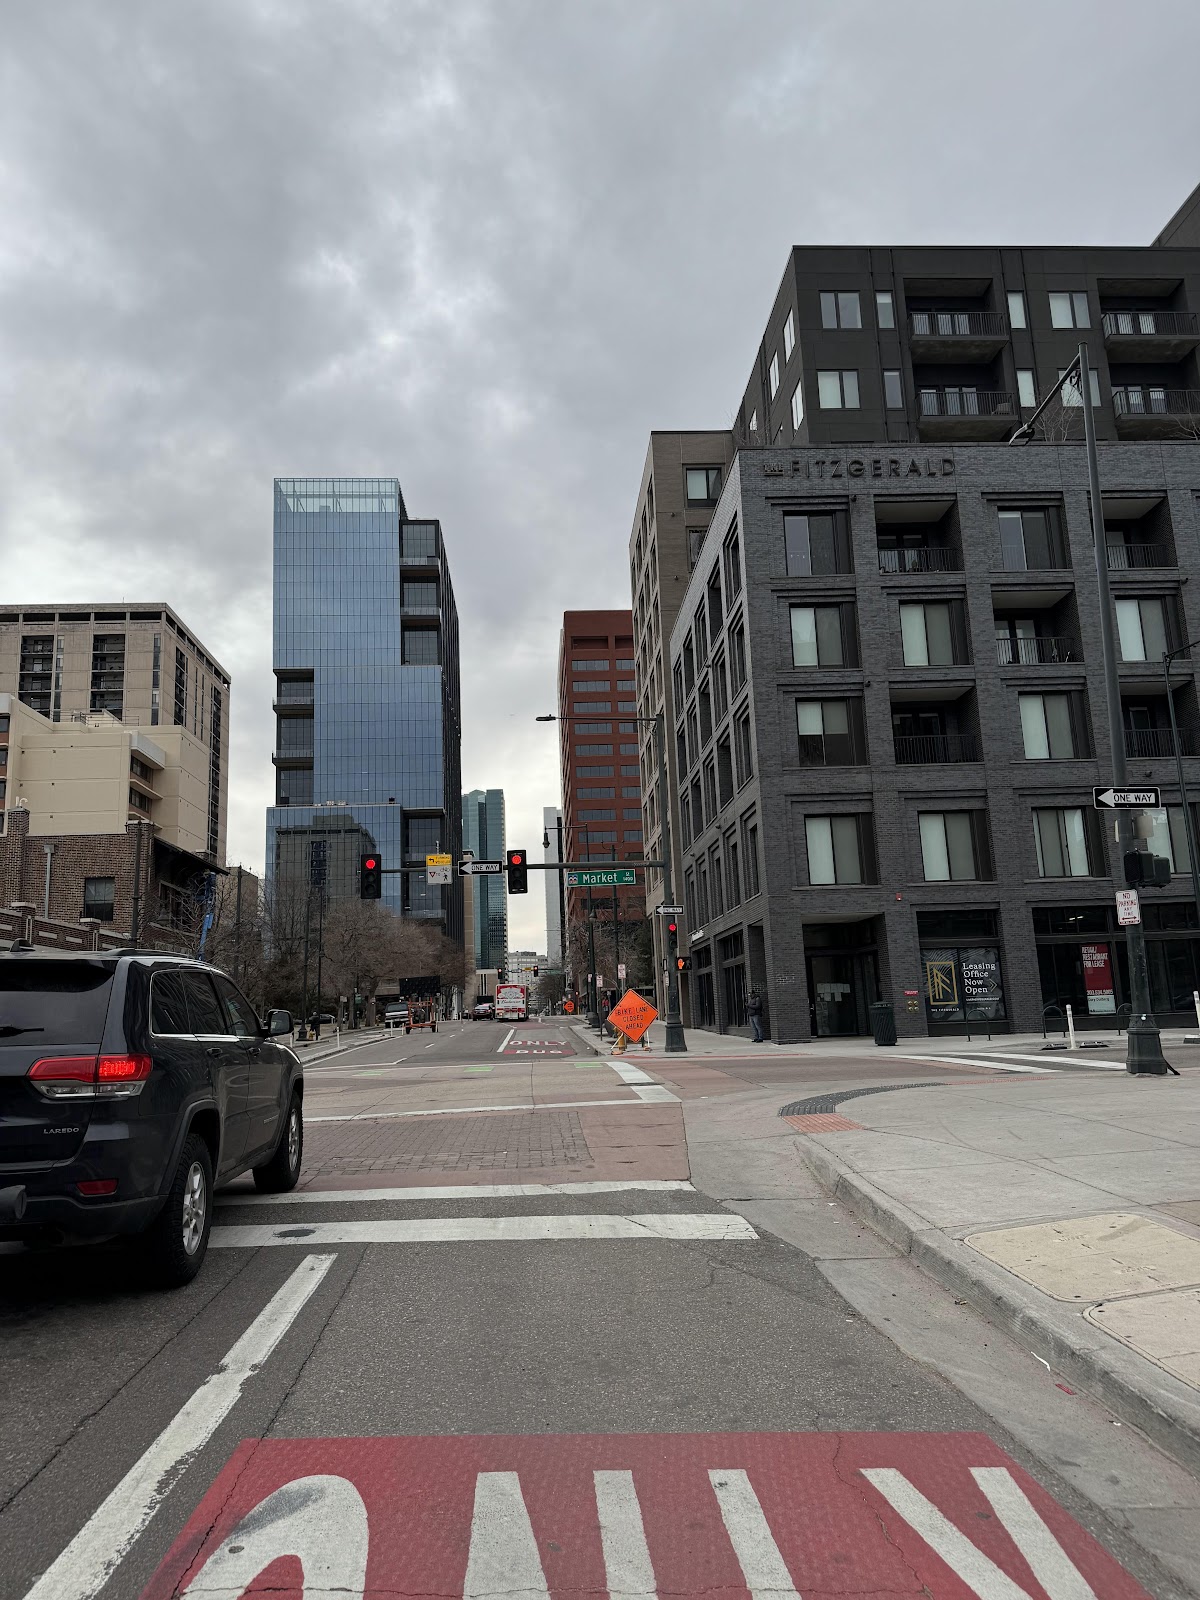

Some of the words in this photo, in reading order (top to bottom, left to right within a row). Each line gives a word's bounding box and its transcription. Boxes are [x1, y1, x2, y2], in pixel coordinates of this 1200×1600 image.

[790, 458, 956, 479] FITZGERALD
[1113, 793, 1131, 802] ONE
[1134, 793, 1152, 803] WAY
[582, 872, 618, 884] Market
[1118, 899, 1136, 907] PARKING
[962, 962, 996, 971] Leasing
[965, 986, 988, 995] Open
